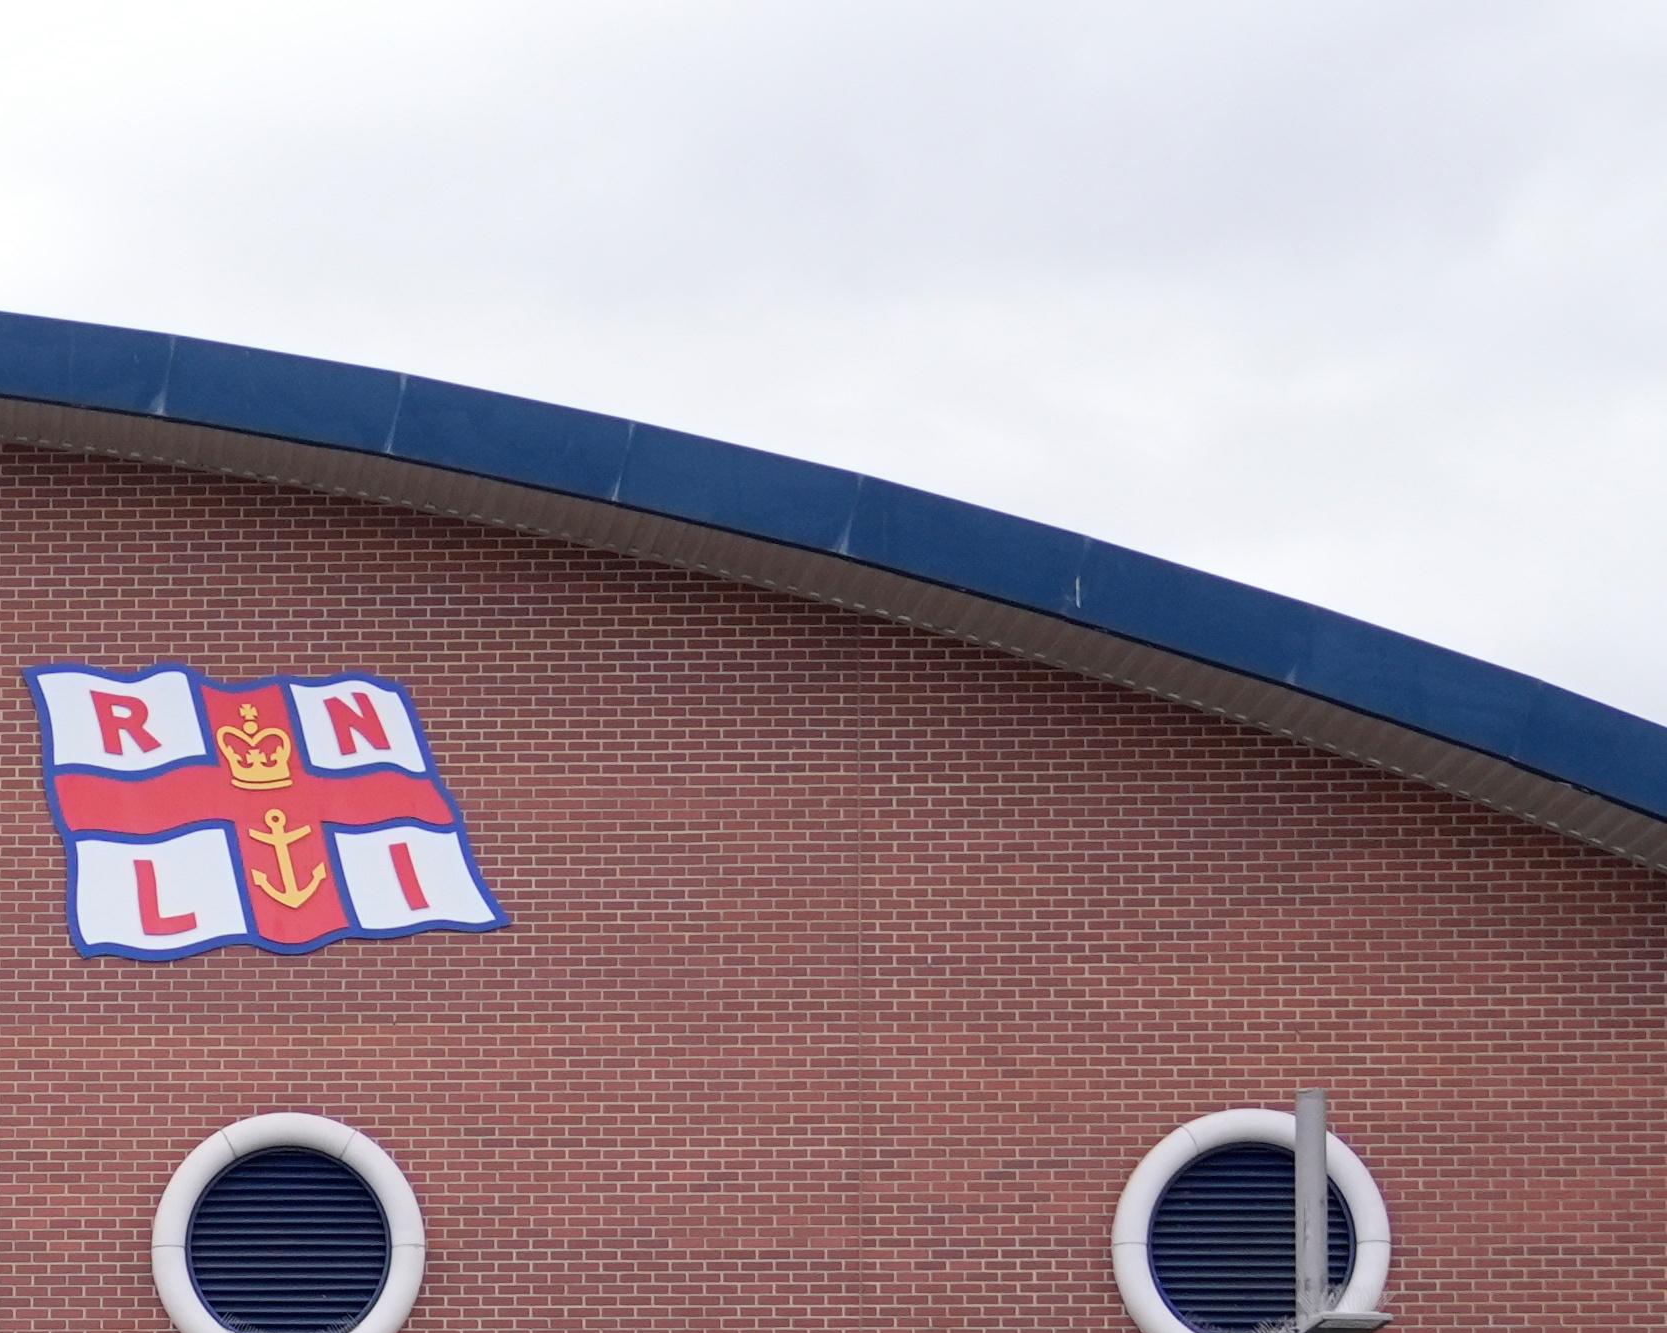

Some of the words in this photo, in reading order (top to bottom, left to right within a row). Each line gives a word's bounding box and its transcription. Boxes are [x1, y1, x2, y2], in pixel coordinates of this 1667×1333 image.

[90, 690, 161, 755] R
[323, 692, 391, 755] N
[133, 858, 197, 935] L
[388, 842, 429, 910] I
